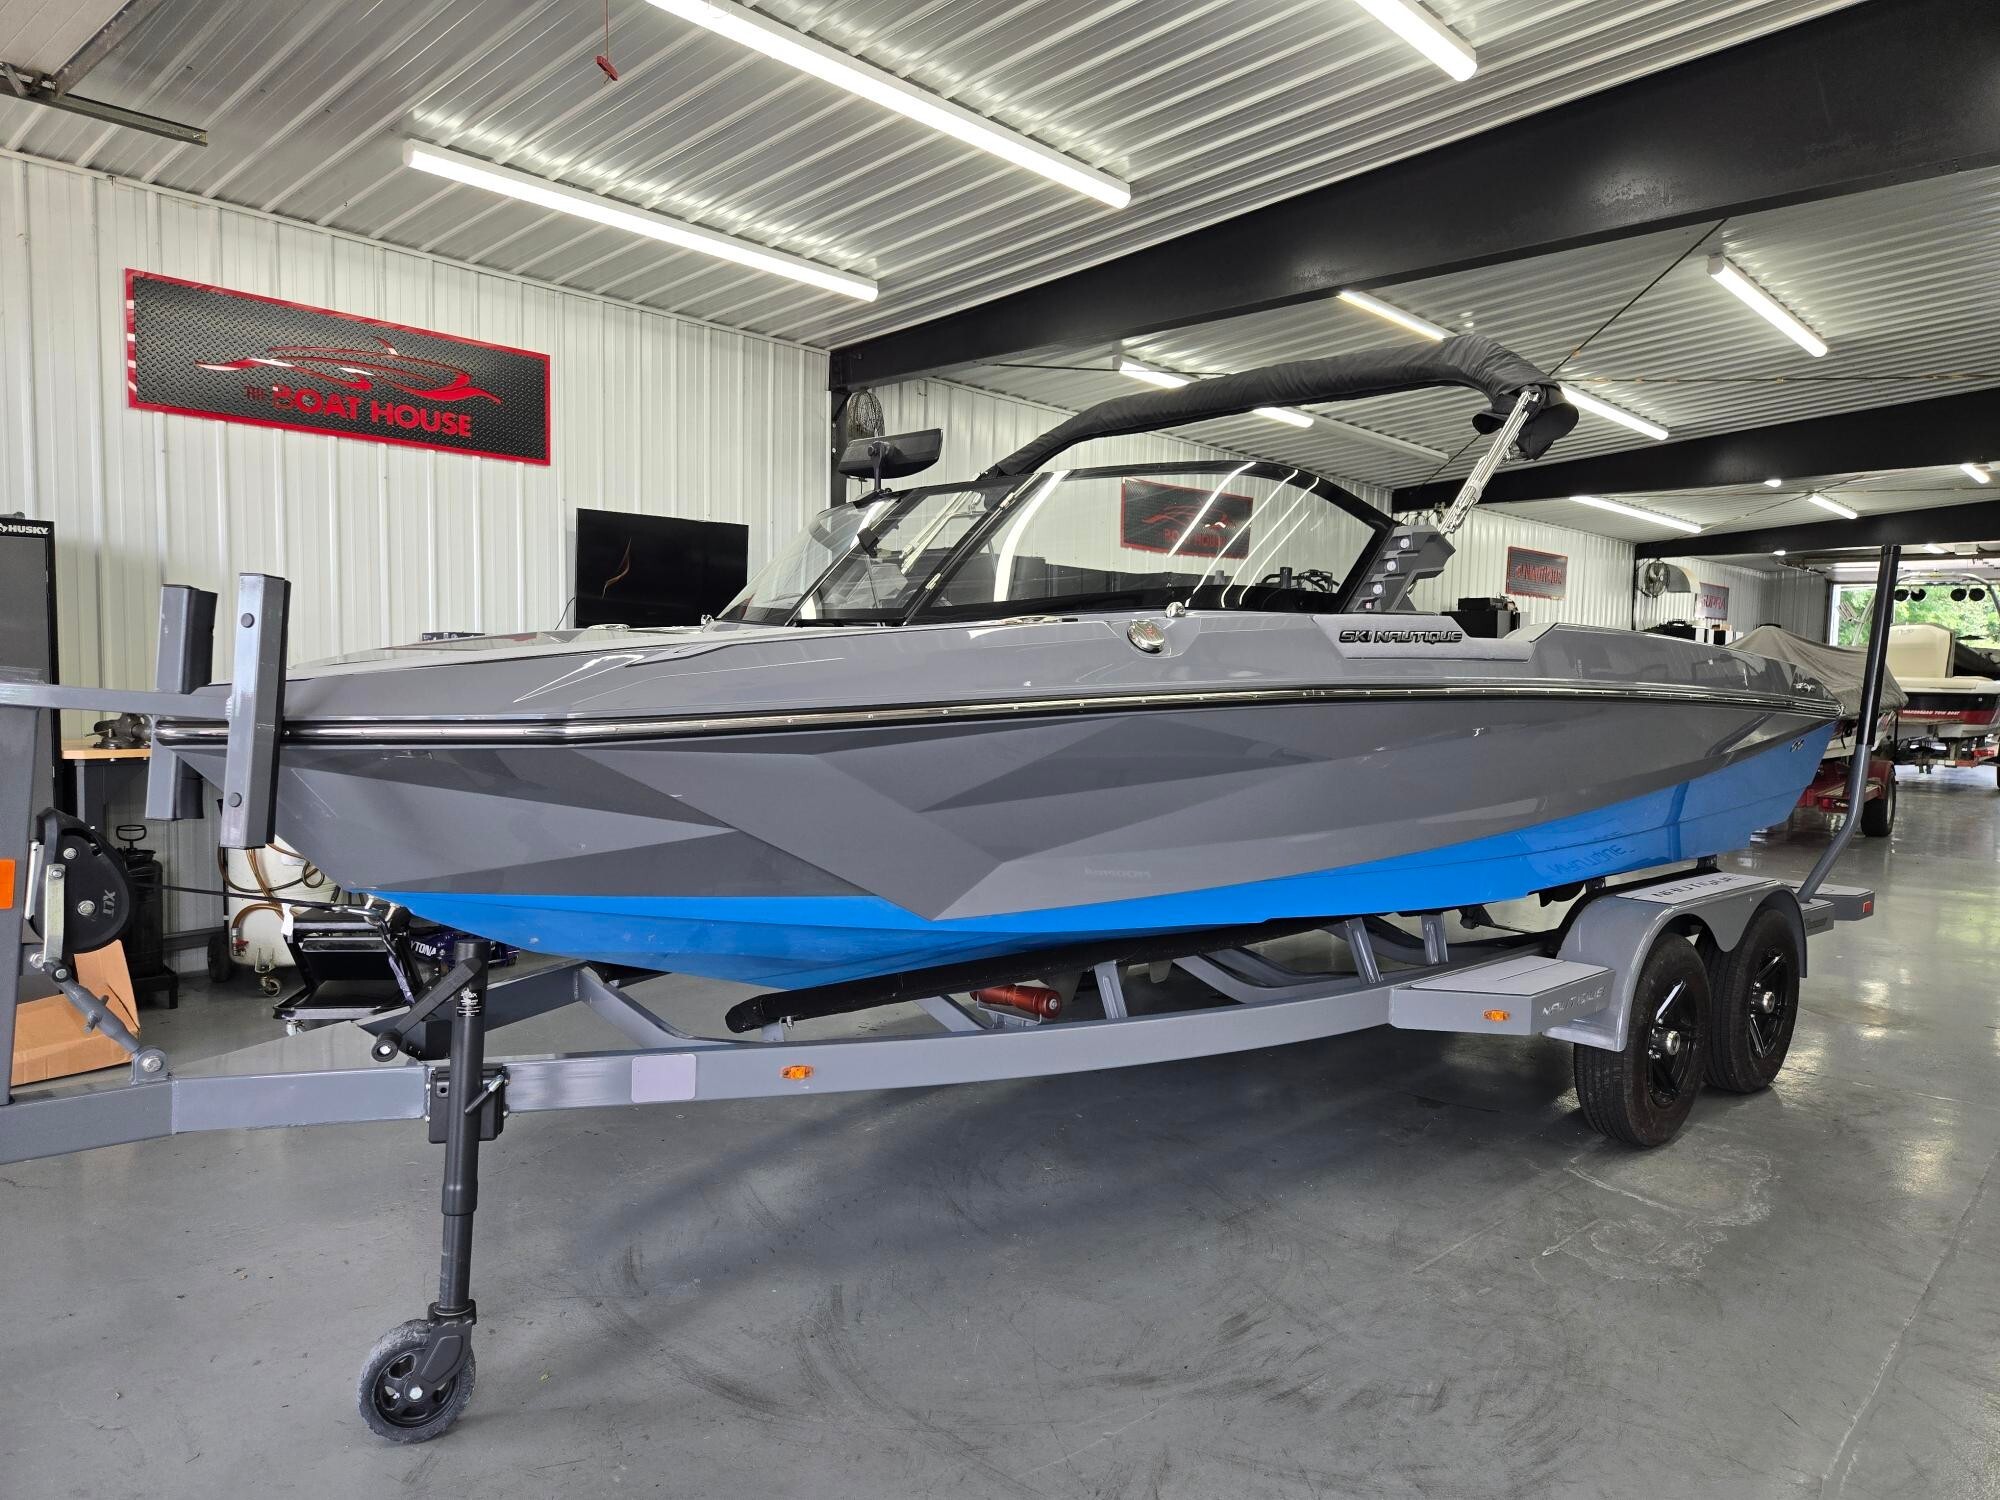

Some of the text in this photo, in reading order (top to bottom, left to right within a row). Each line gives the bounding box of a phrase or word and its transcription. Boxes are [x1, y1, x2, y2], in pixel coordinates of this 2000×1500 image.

[272, 383, 362, 420] BOAT
[370, 400, 472, 437] HOUSE
[8, 524, 49, 535] HUSKY
[1339, 630, 1463, 645] SKI NAUTIQUE
[102, 889, 116, 918] XLT
[410, 940, 437, 957] YTONA
